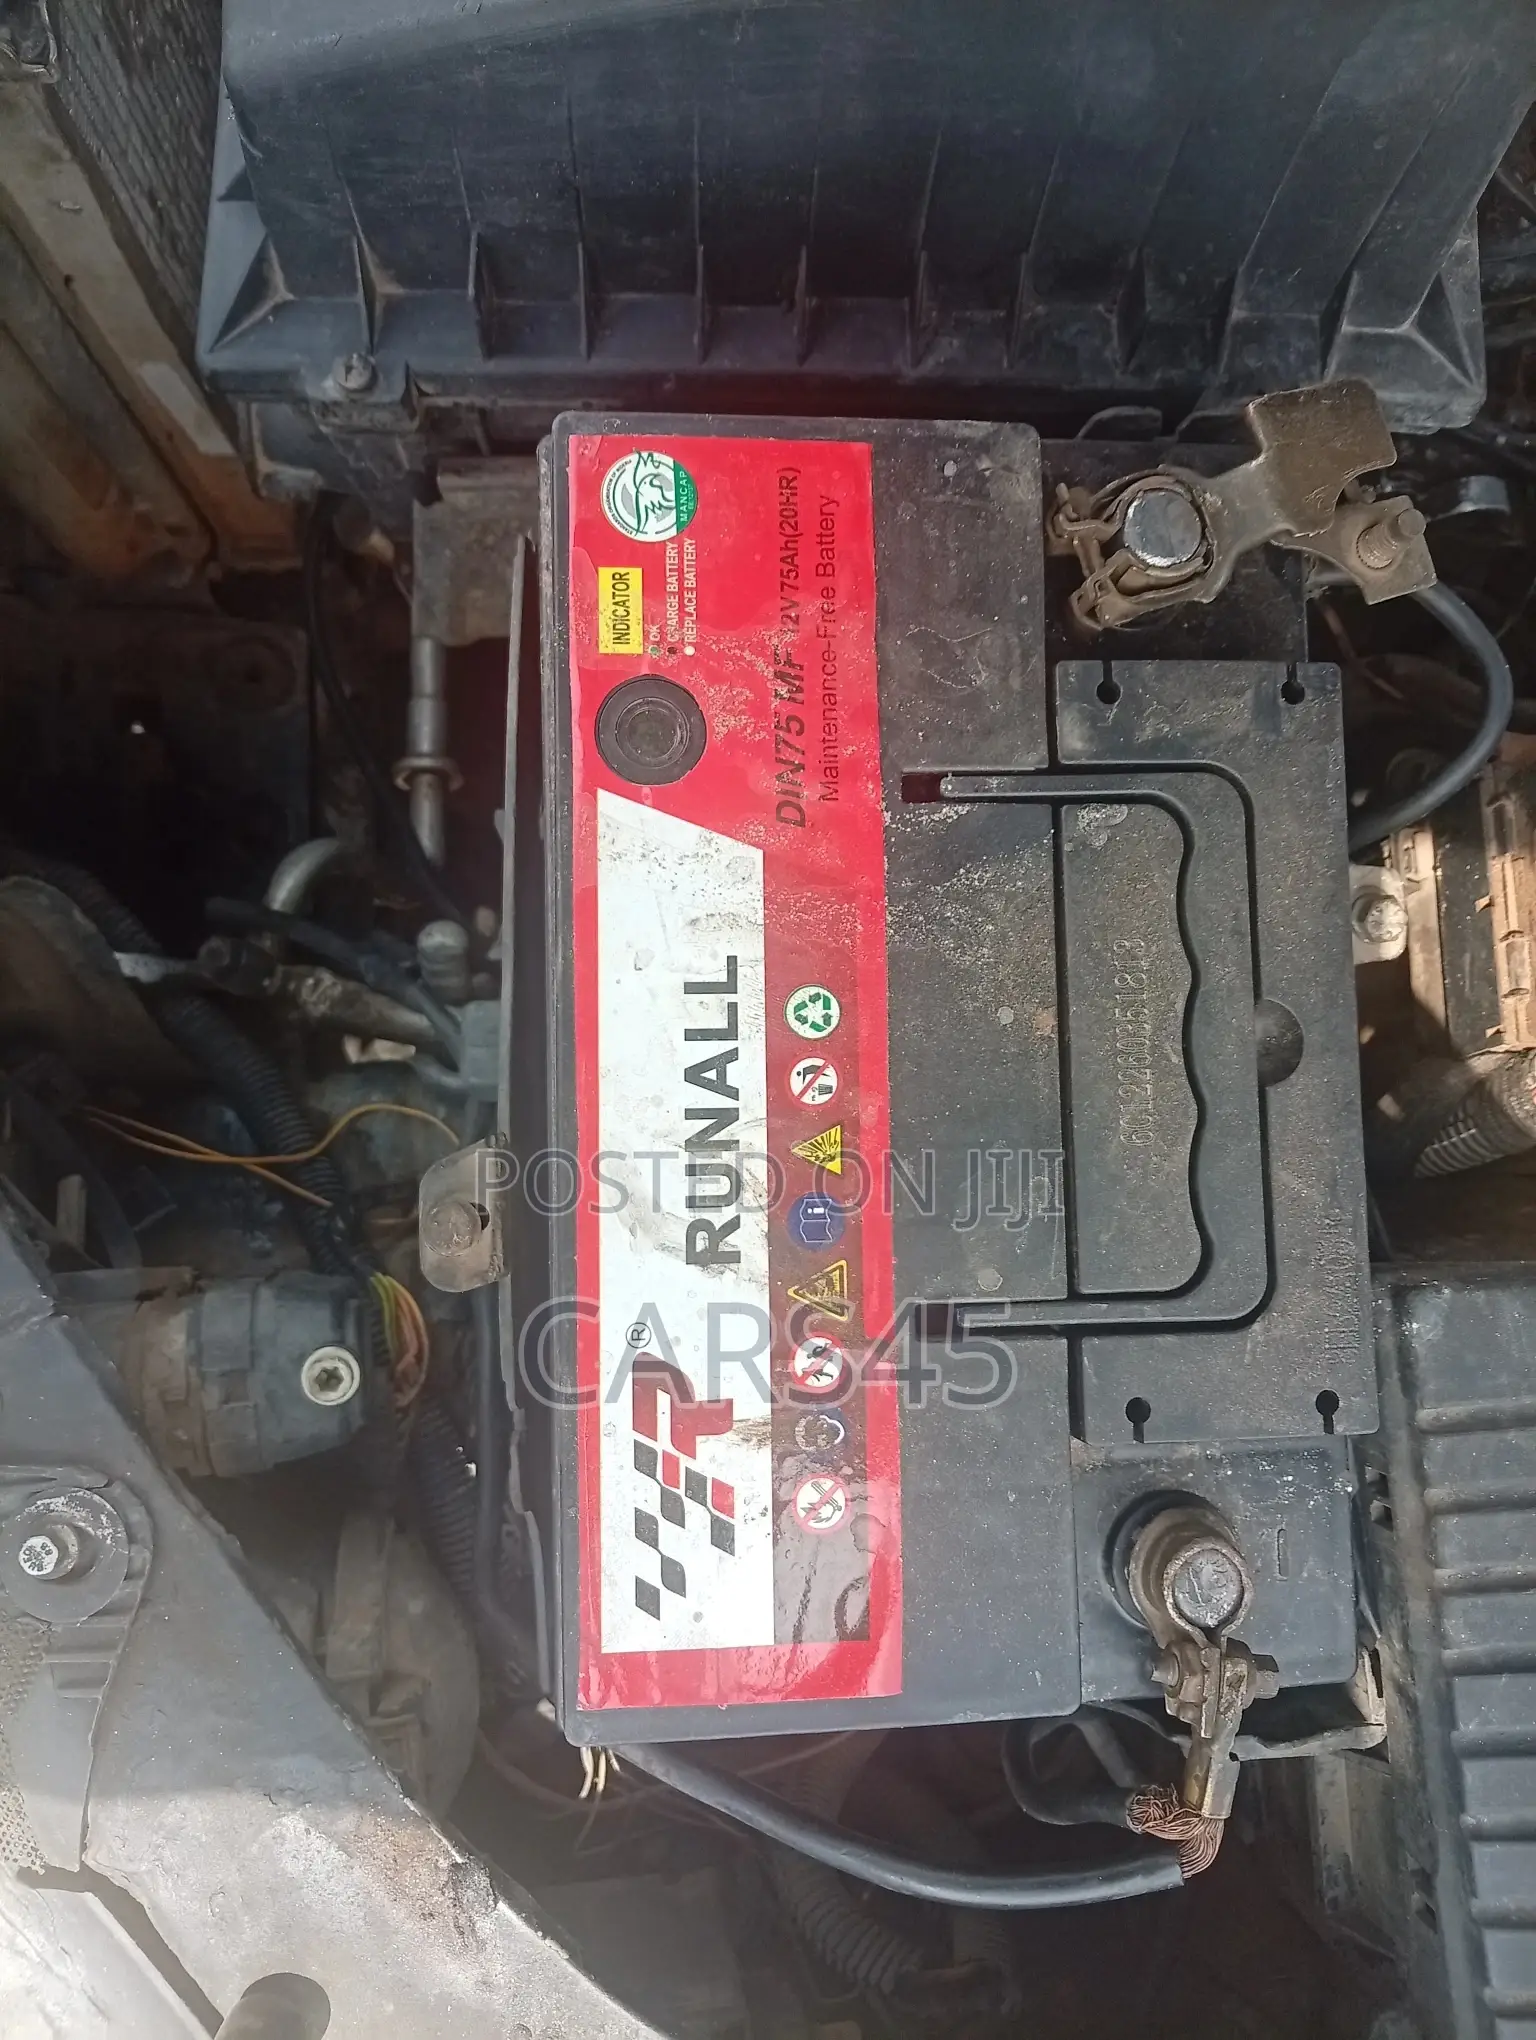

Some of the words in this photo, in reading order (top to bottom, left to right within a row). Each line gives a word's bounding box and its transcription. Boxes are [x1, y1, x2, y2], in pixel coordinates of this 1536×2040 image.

[679, 471, 688, 522] MANCAP
[684, 538, 697, 588] BATTERY
[815, 495, 839, 577] Battery
[665, 541, 678, 592] BATTERY
[612, 571, 630, 645] INDICATOR
[649, 624, 660, 641] OK
[666, 594, 679, 642] CHARGE
[684, 589, 697, 643] REPLACE
[774, 643, 804, 705] MF
[816, 586, 840, 801] Maintenance-Free
[774, 712, 806, 828] DIN75
[683, 955, 742, 1266] RUNALL
